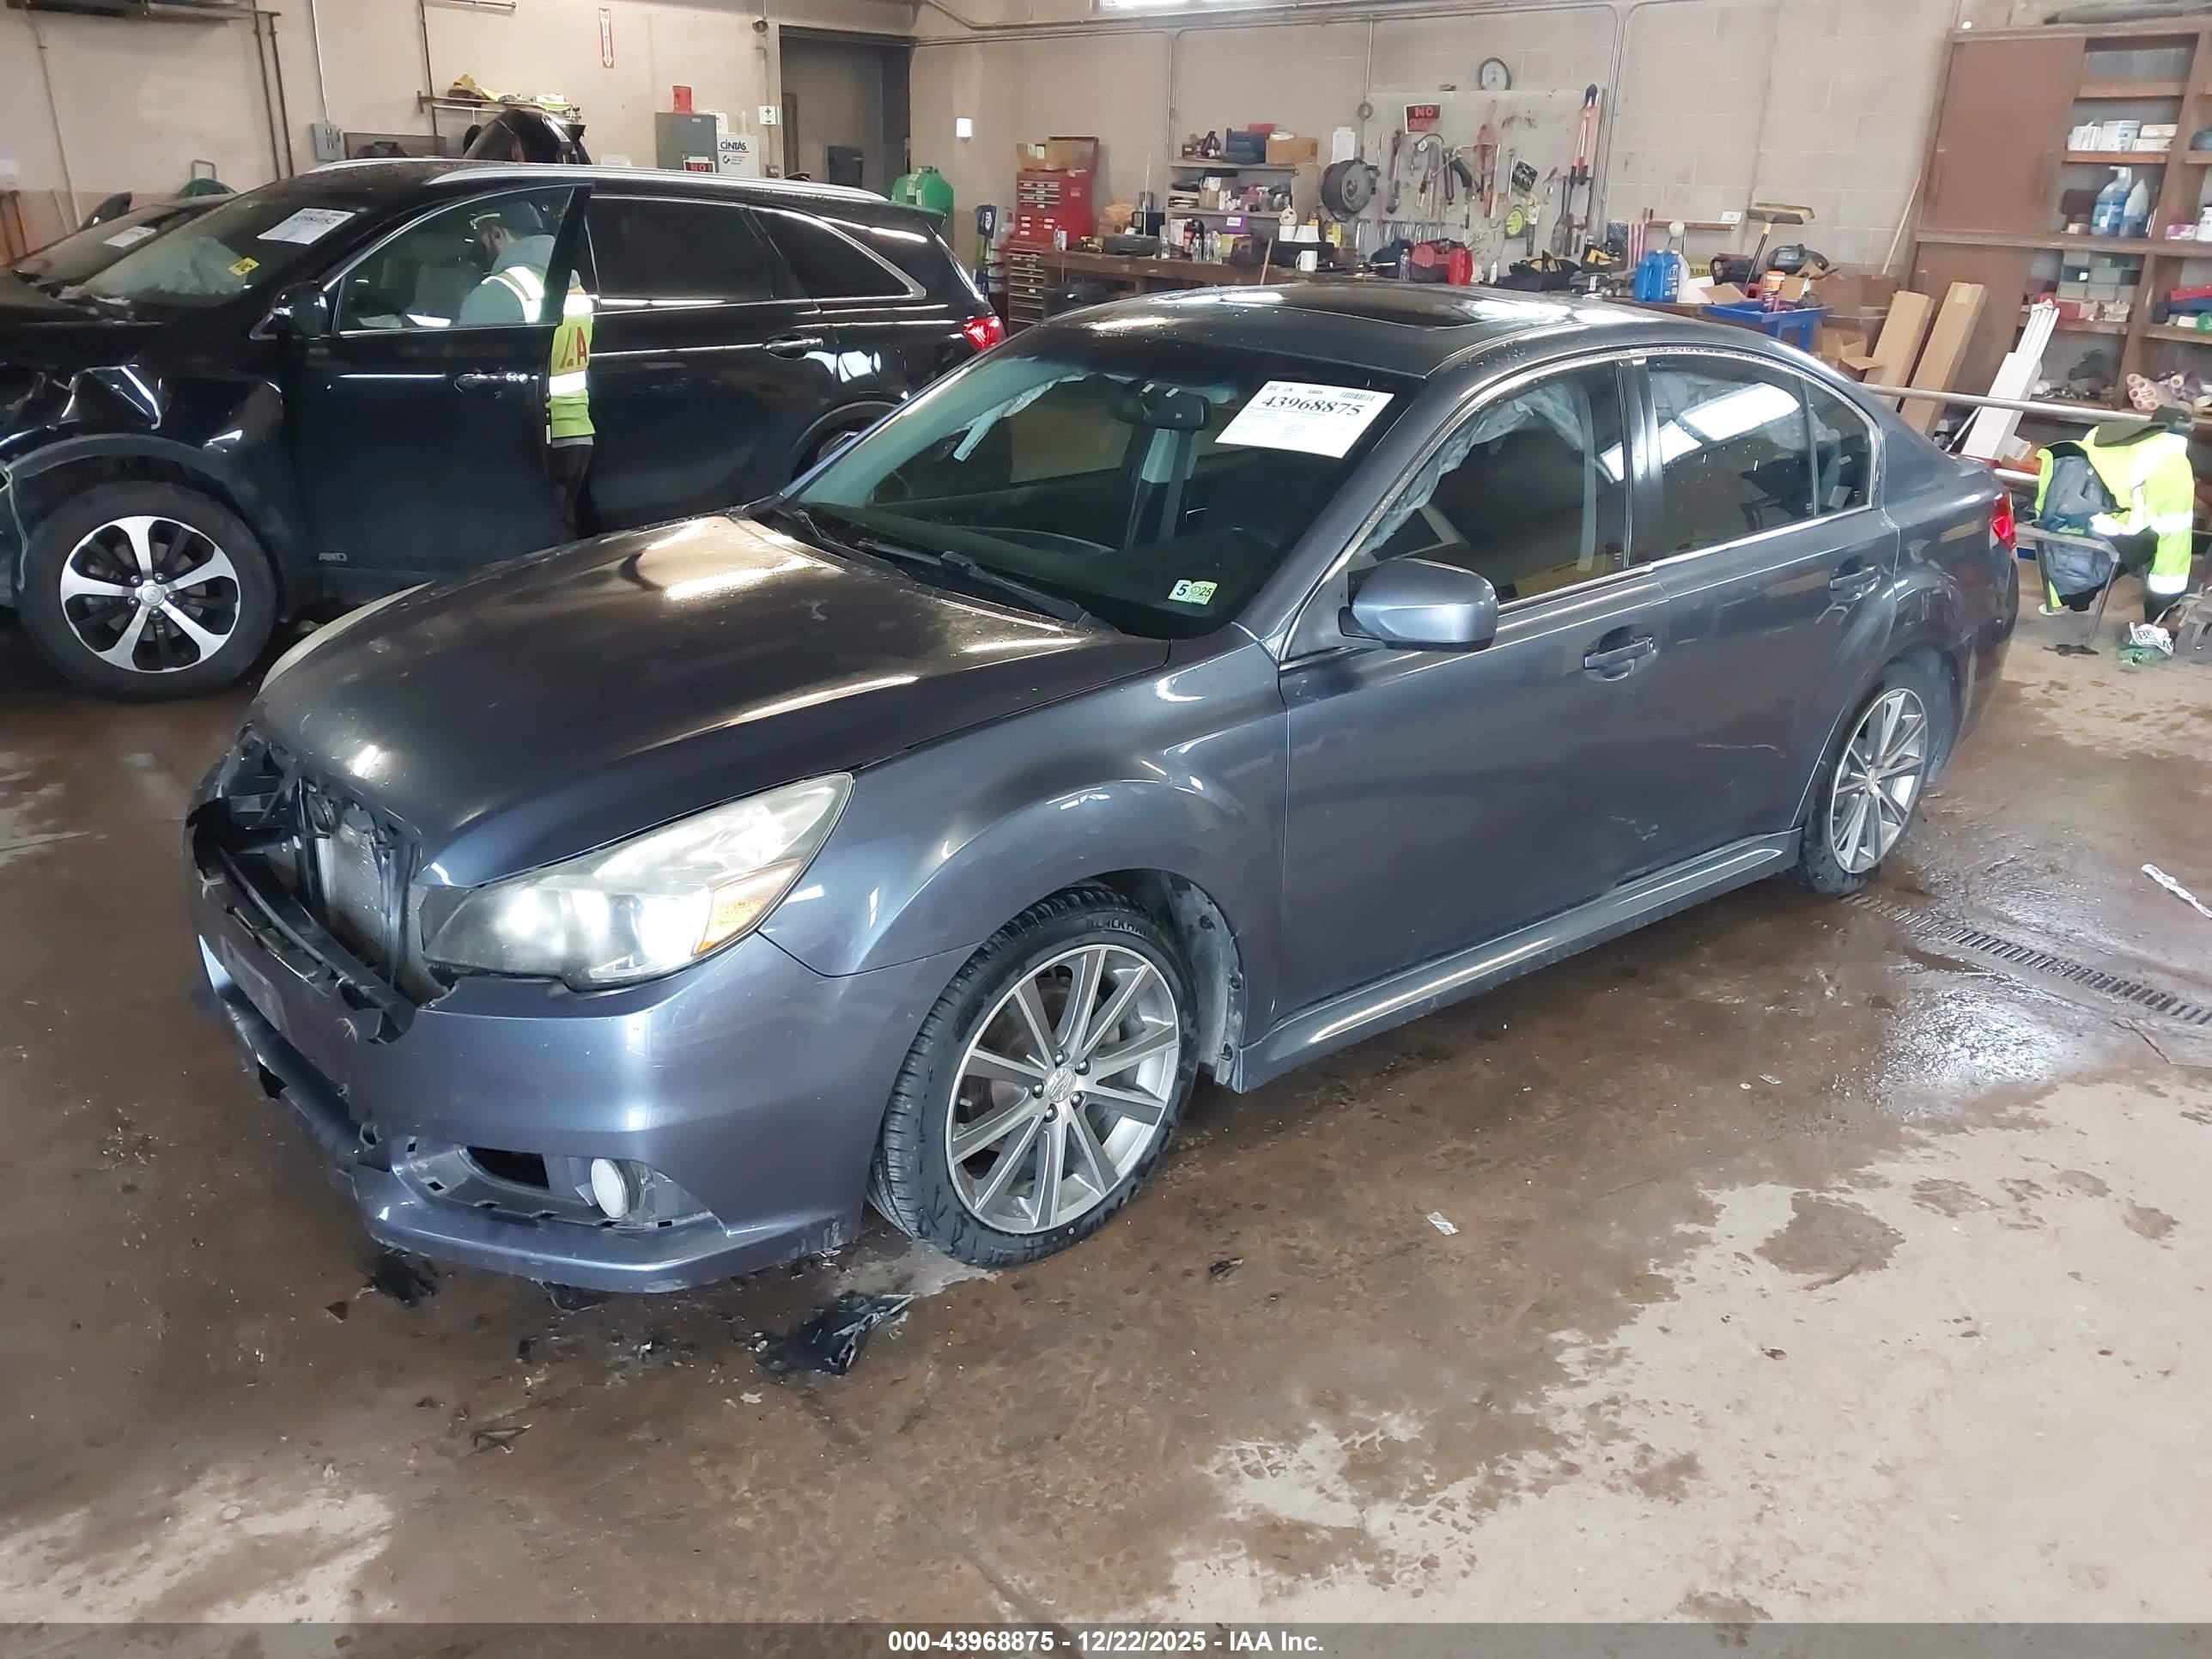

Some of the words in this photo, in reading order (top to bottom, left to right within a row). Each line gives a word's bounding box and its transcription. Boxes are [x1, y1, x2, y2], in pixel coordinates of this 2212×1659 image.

[1414, 106, 1433, 117] NO
[1261, 395, 1364, 416] 43968875
[1176, 584, 1189, 596] 5
[1200, 586, 1213, 597] 25
